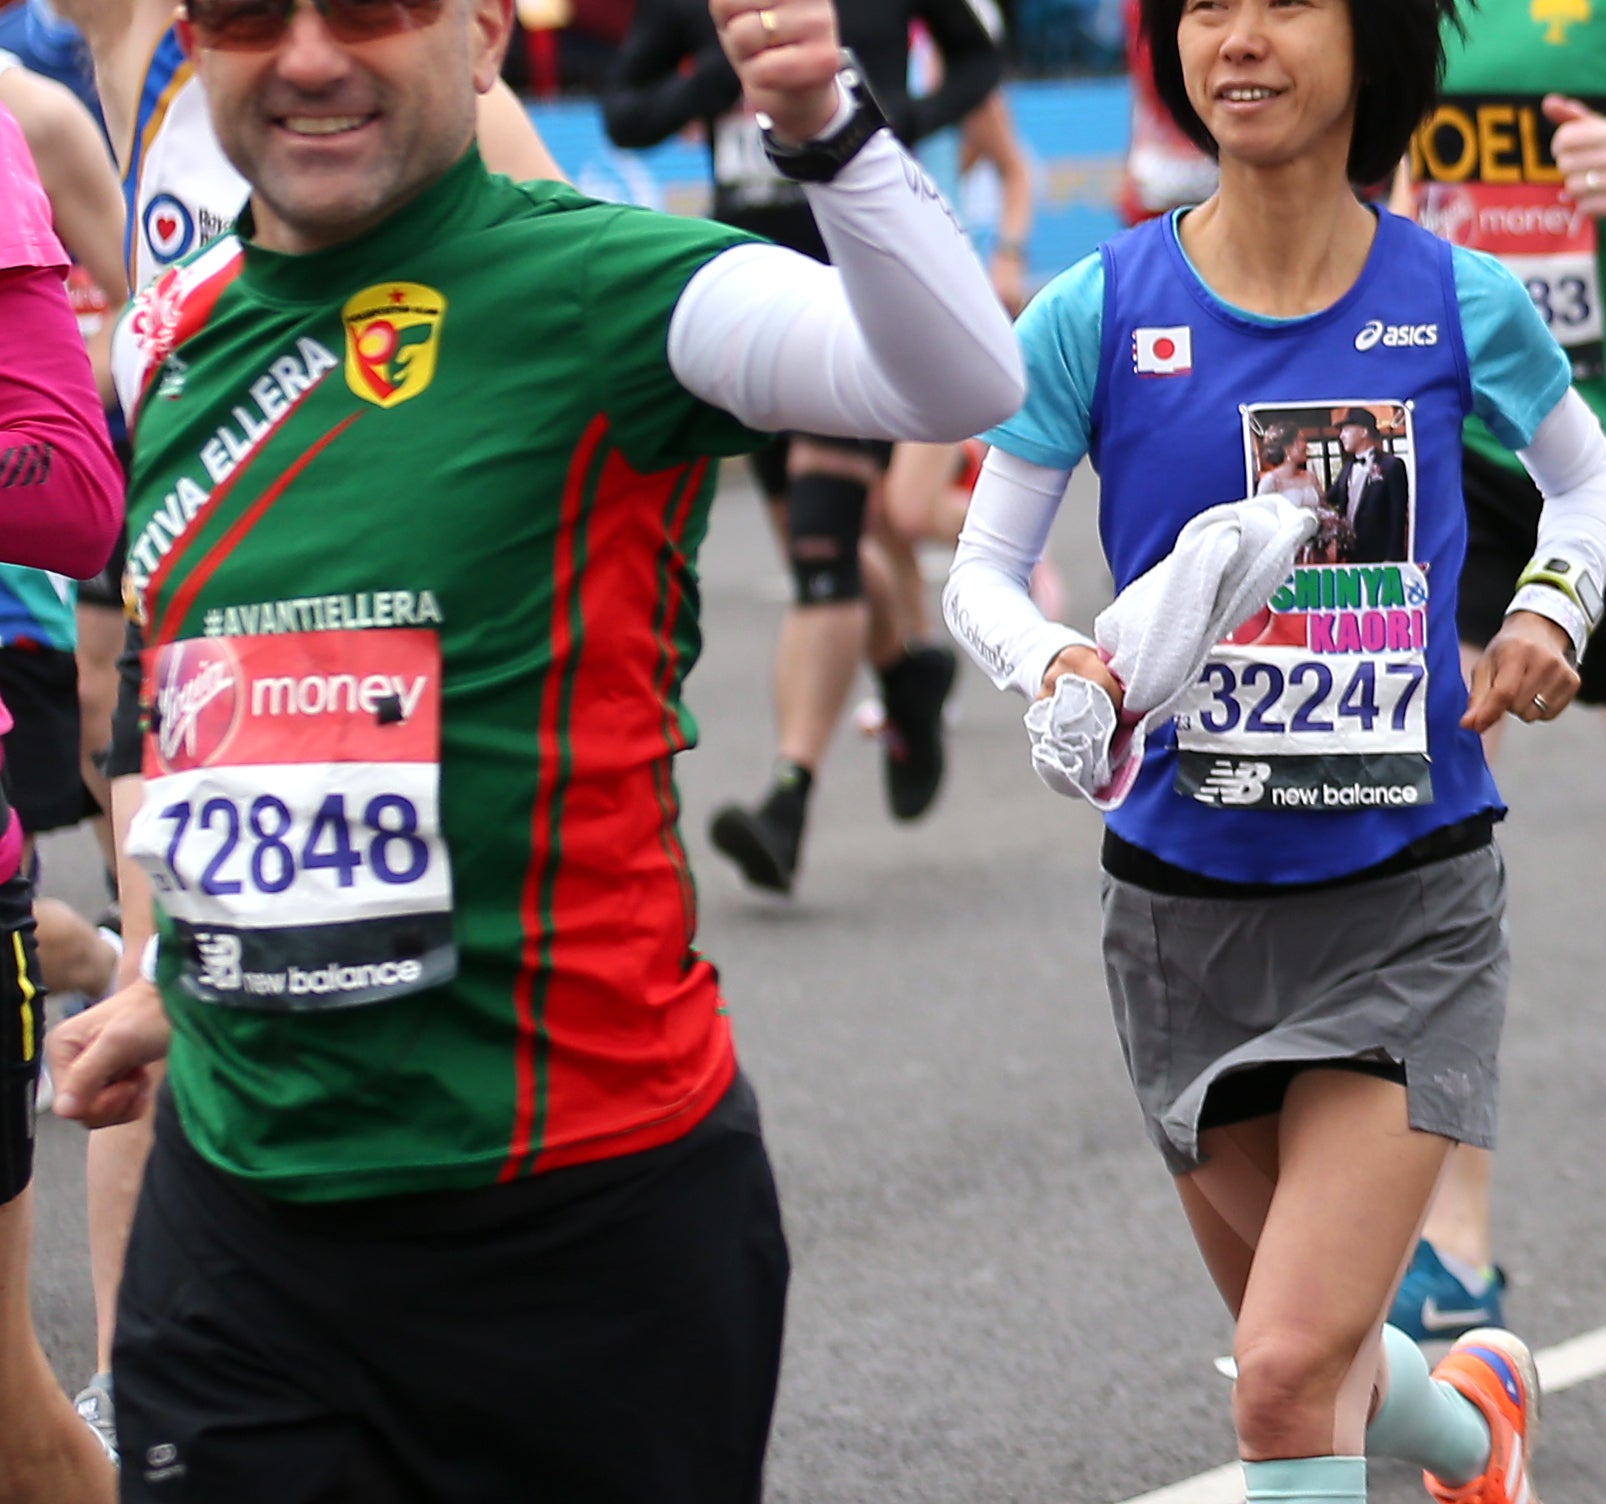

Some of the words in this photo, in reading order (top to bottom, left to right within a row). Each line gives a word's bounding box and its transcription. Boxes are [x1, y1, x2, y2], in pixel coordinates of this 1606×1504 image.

[1480, 202, 1582, 240] money
[1382, 322, 1439, 348] asics
[200, 337, 338, 485] ELLERA
[1270, 565, 1406, 612] SHINYA
[204, 590, 442, 637] #AVANTIELLERA
[1310, 609, 1426, 655] KAORI
[251, 673, 428, 726] money
[1199, 660, 1425, 735] 32247
[1272, 787, 1319, 807] new
[1323, 782, 1418, 805] balance
[288, 956, 424, 995] balance
